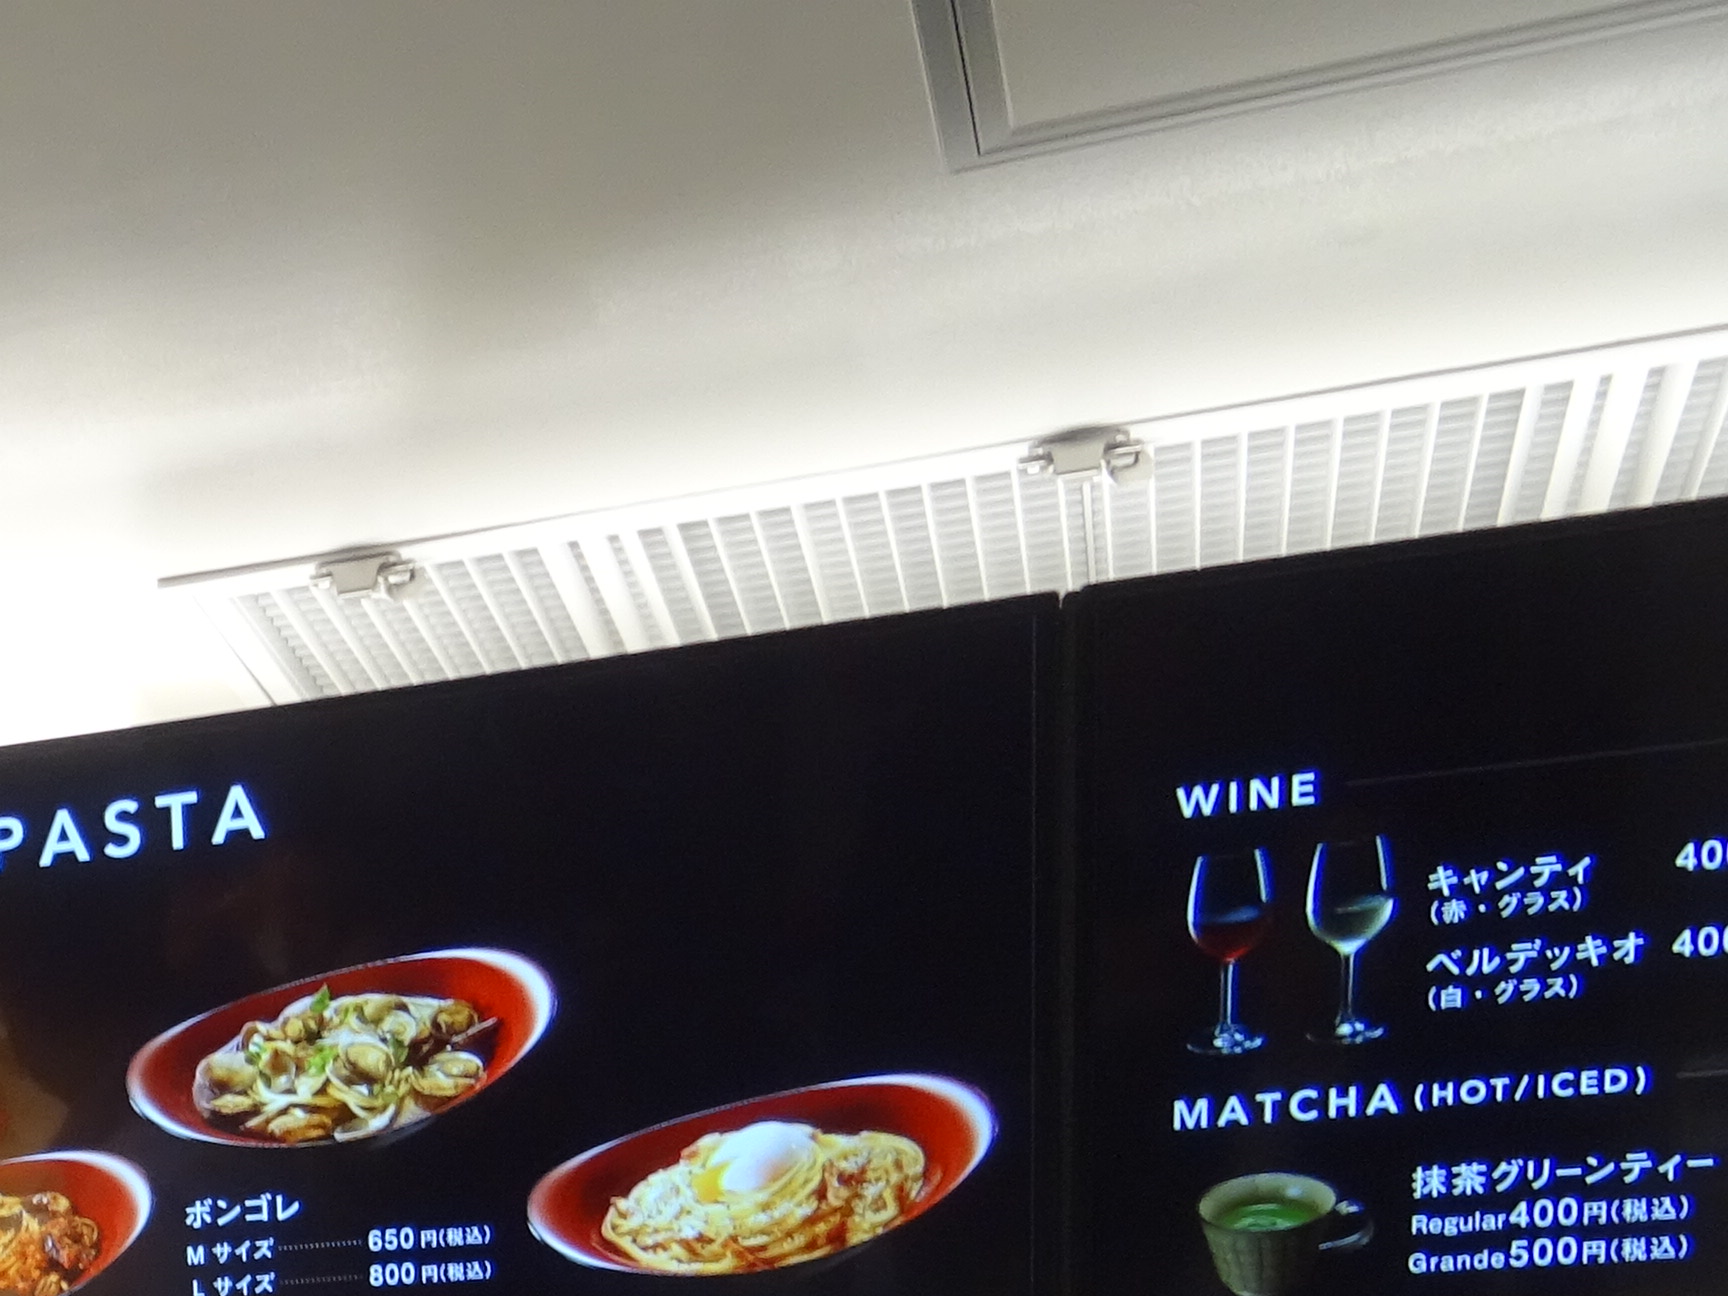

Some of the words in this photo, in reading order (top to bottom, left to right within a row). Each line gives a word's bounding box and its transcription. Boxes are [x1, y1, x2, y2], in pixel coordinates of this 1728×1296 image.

[1177, 772, 1317, 819] WINE
[1428, 856, 1592, 897] キャンティ
[1675, 839, 1728, 872] 40
[1426, 931, 1645, 978] ベルデッキオ
[1173, 1081, 1400, 1132] MATCHA
[1414, 1065, 1648, 1113] (HOT/ICED)
[1412, 1152, 1715, 1199] 抹茶グリーンティー
[185, 1192, 300, 1229] ボンゴレ
[367, 1227, 415, 1252] 650
[368, 1262, 415, 1287] 800
